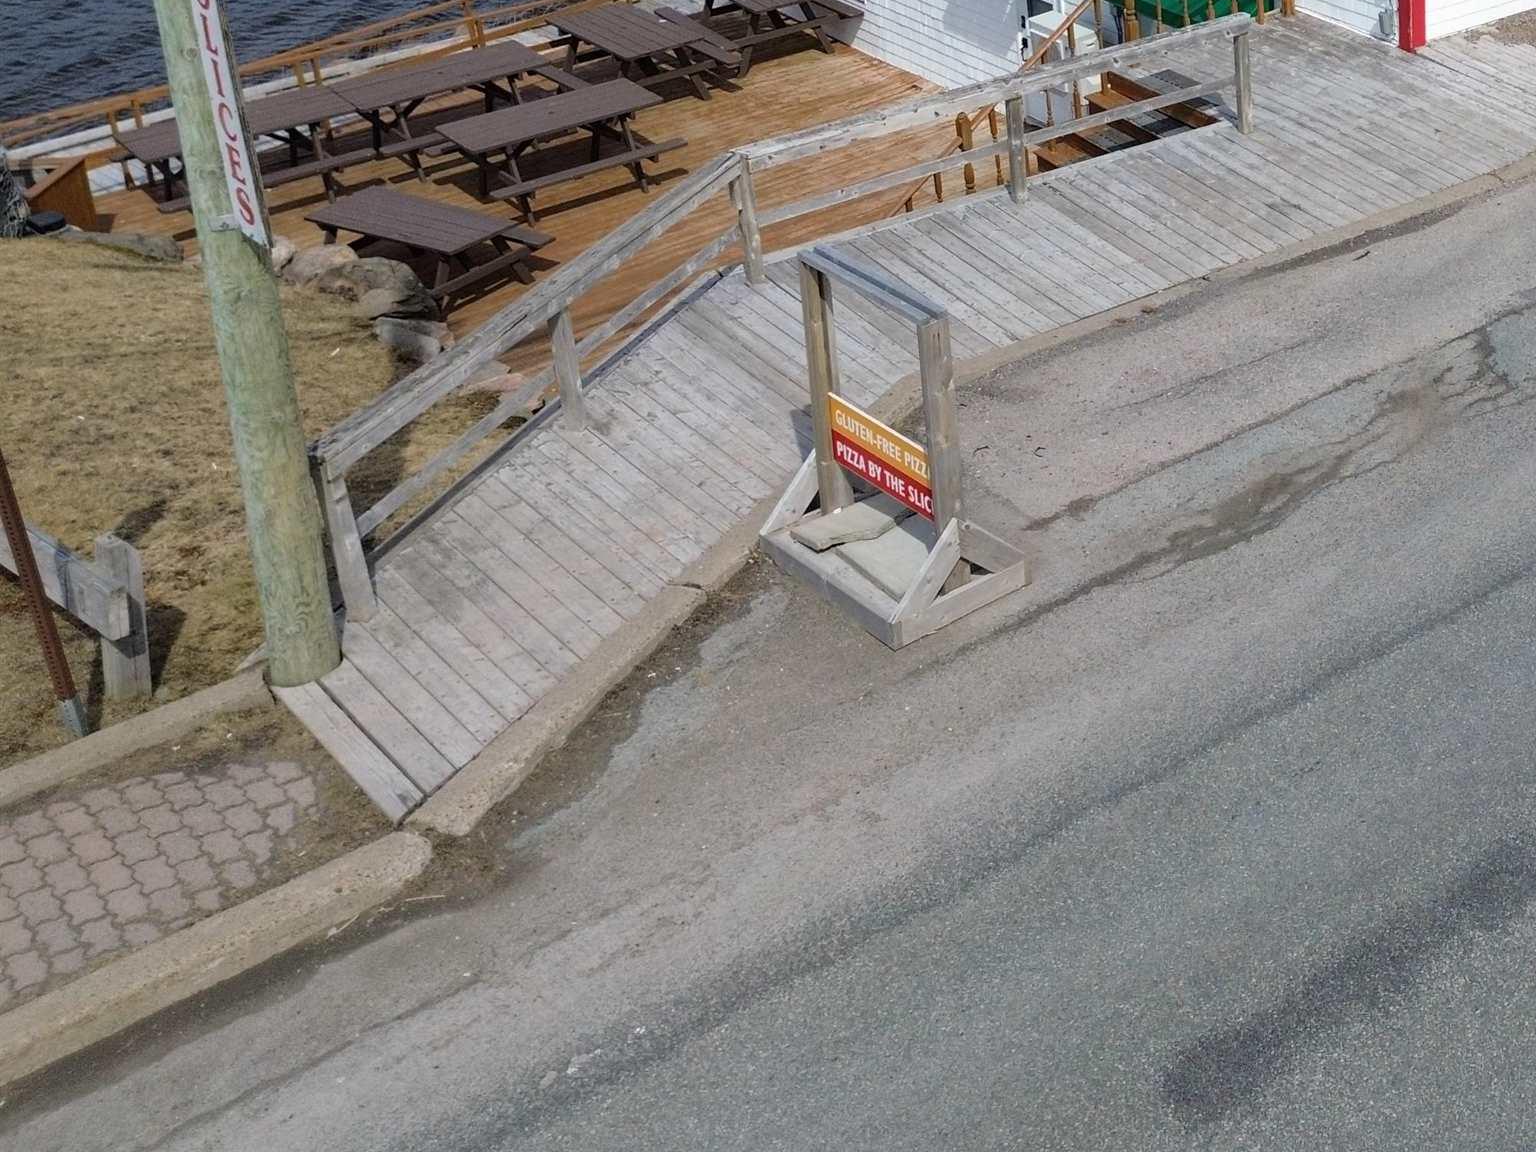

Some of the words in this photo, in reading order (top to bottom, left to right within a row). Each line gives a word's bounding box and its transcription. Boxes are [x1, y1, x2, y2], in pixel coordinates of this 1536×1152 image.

[835, 409, 902, 463] GLUTEN-FREE
[904, 451, 931, 481] PIZZ
[836, 440, 867, 473] PIZZA
[867, 459, 882, 481] BY
[883, 468, 906, 497] THE
[907, 484, 935, 515] SLIC
